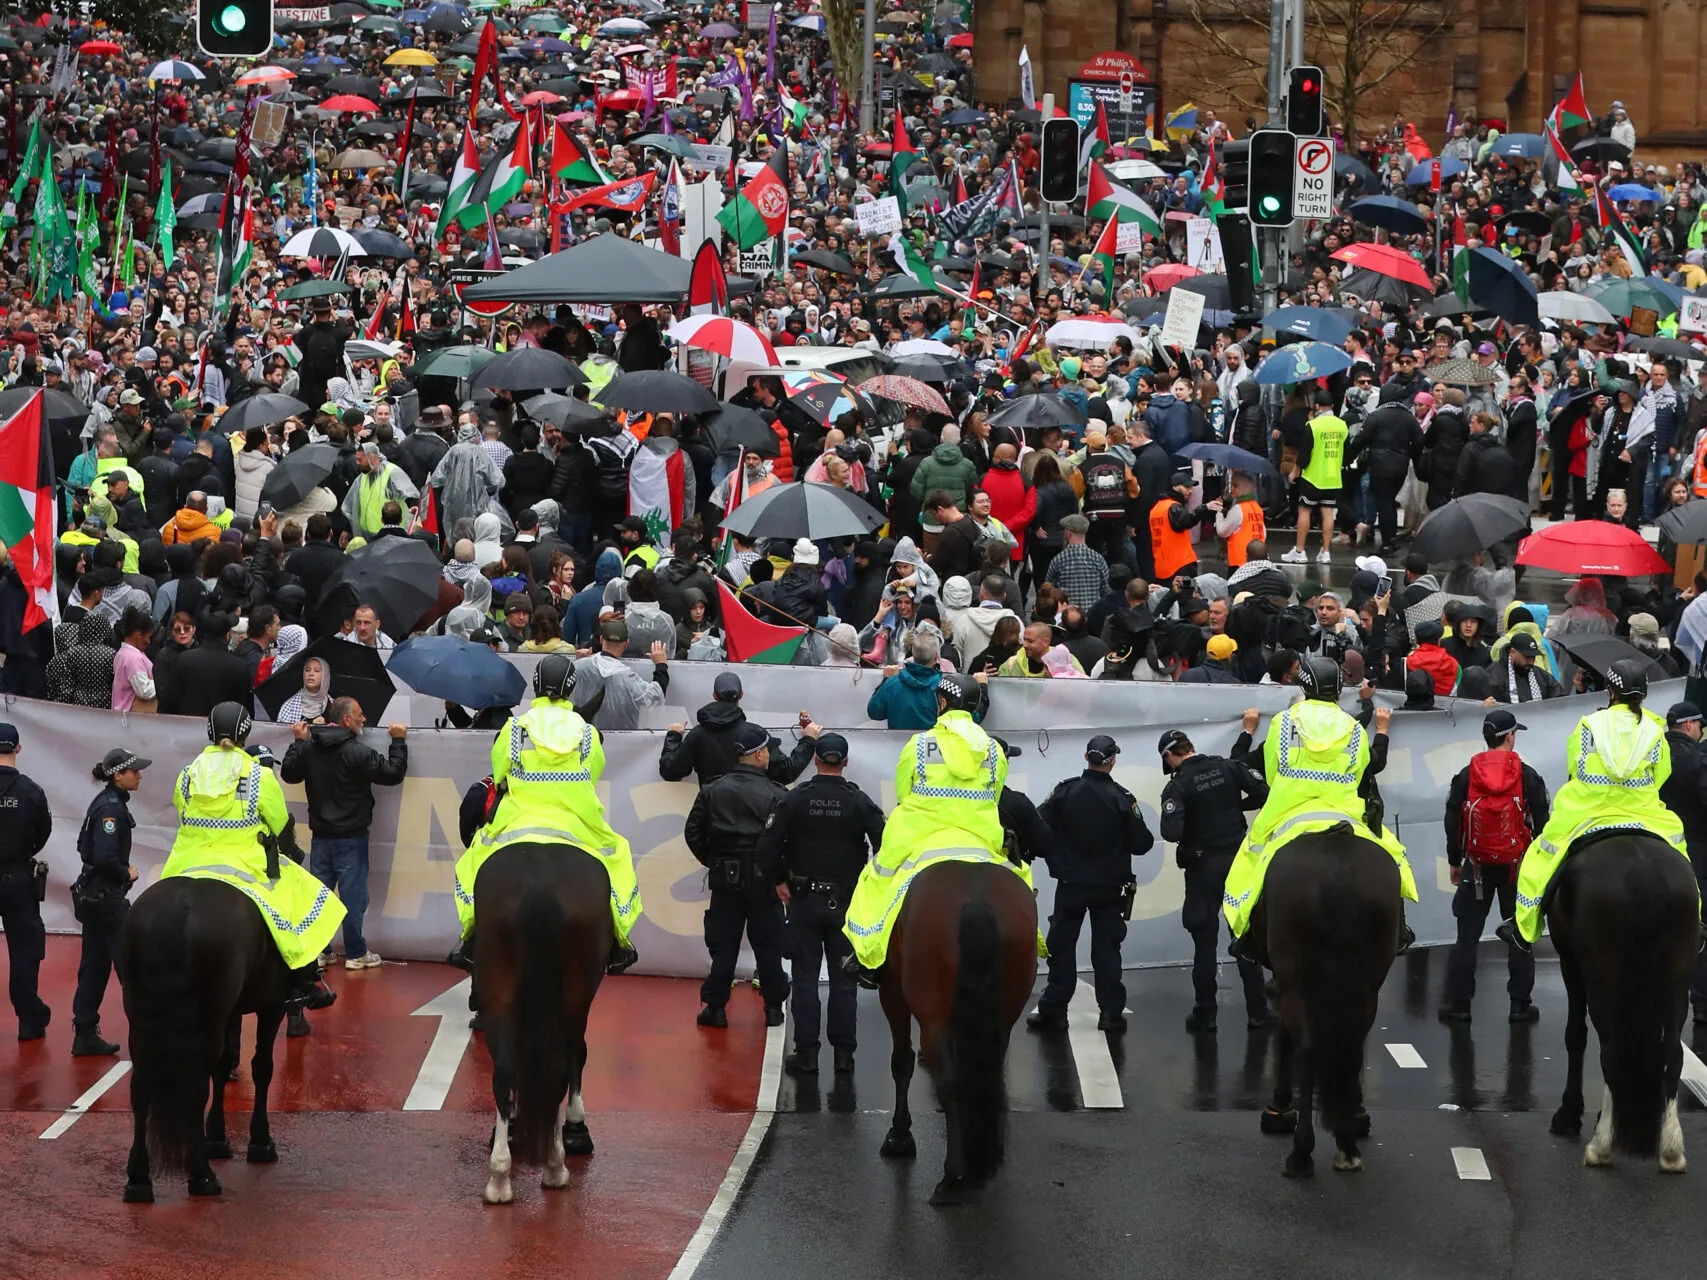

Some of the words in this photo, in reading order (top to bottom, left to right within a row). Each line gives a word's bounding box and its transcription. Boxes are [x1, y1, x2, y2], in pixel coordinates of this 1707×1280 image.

[274, 8, 327, 21] ALESTINE
[1303, 178, 1324, 190] NO
[1298, 193, 1328, 202] RIGHT
[860, 206, 892, 220] ZIONIST
[1299, 204, 1327, 213] TURN
[741, 253, 771, 261] WA
[740, 261, 773, 270] CRIMIN
[1193, 768, 1222, 783] POLICE
[810, 799, 841, 807] POLICE
